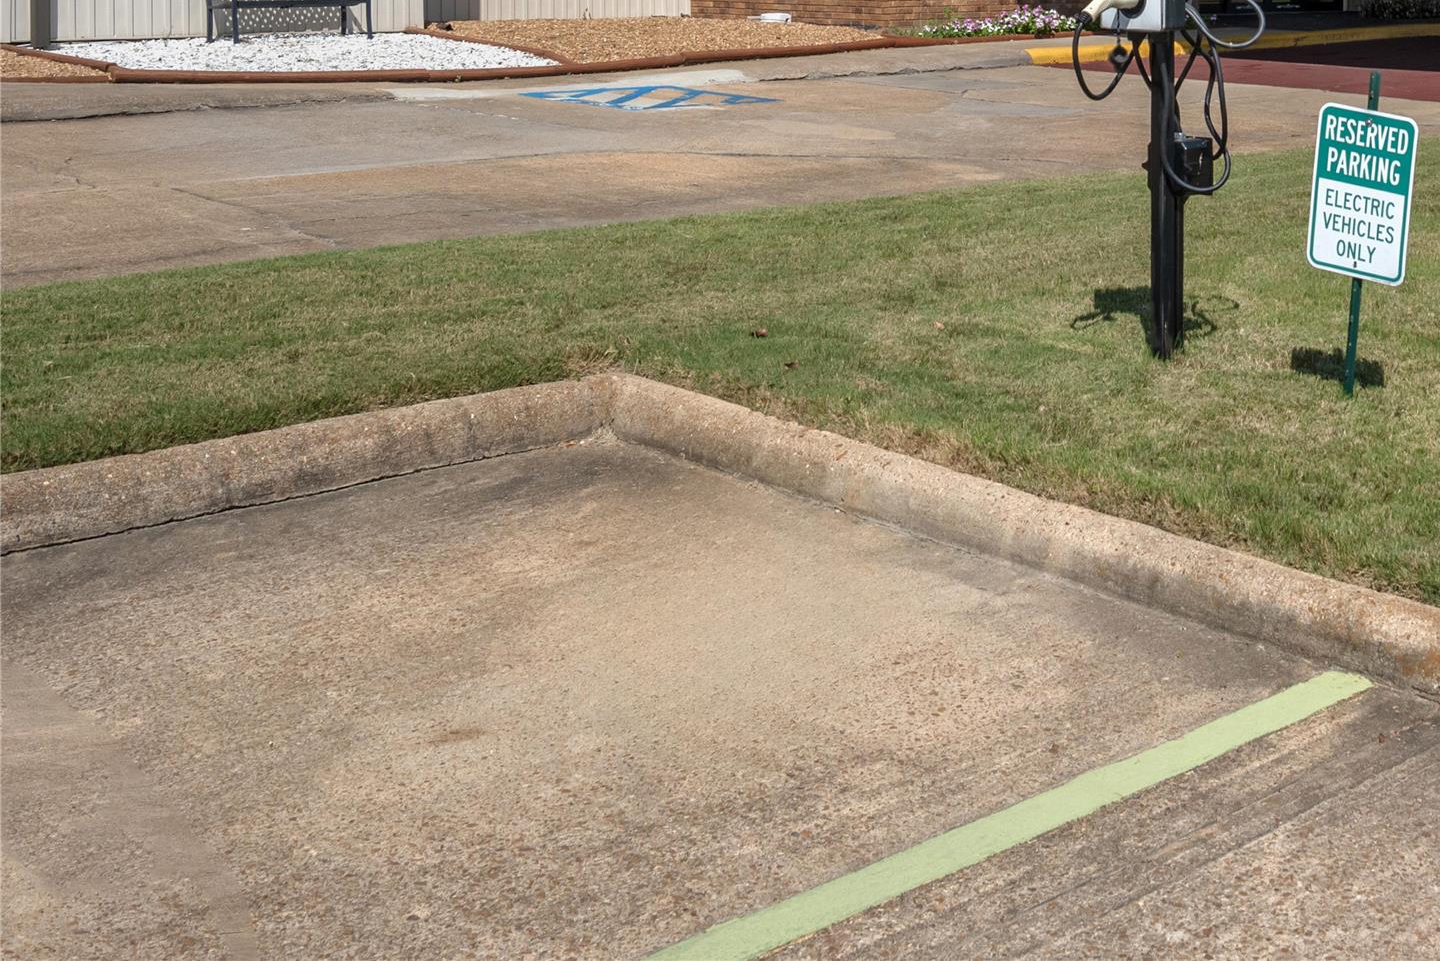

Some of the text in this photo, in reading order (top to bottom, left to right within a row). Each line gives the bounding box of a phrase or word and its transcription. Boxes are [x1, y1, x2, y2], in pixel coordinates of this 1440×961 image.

[1325, 114, 1409, 155] RESERVED
[1326, 146, 1401, 186] PARKING
[1325, 188, 1395, 220] ELECTRIC
[1323, 211, 1395, 244] VEHICLES
[1336, 239, 1376, 264] ONLY
